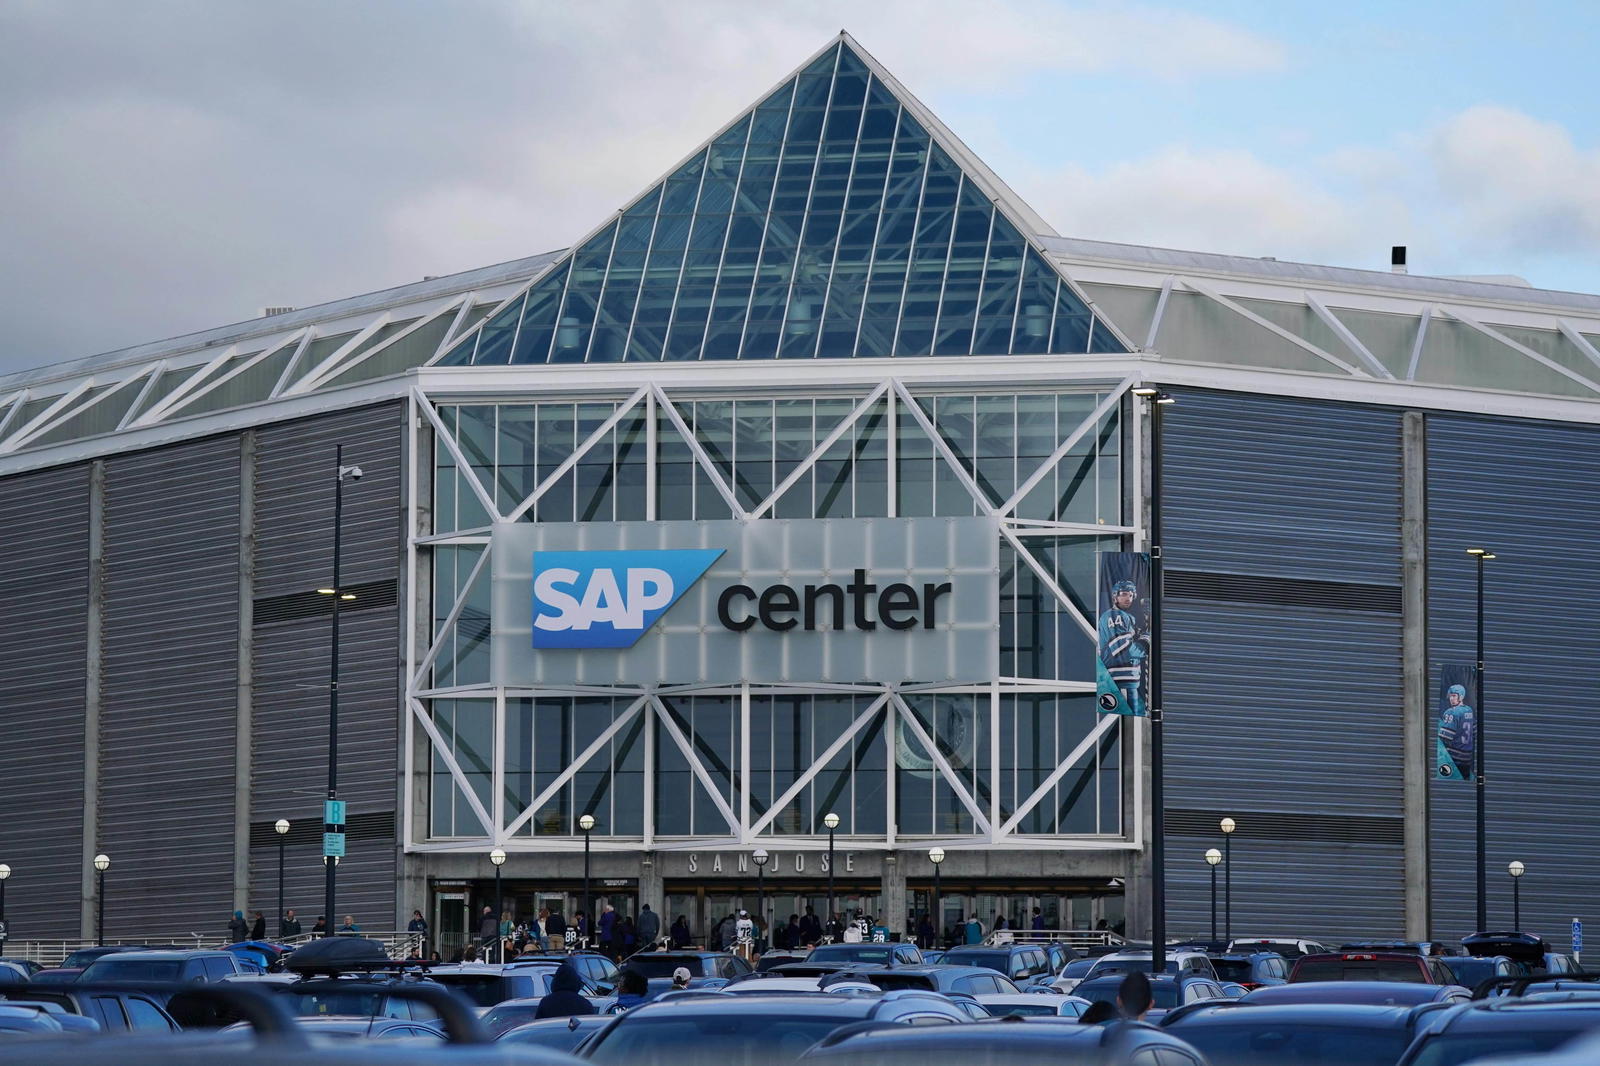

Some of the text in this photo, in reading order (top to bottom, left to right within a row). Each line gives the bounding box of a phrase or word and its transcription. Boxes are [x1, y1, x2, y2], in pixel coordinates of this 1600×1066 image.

[533, 567, 953, 632] SAP center
[1107, 615, 1122, 628] 44
[332, 802, 341, 823] B
[688, 853, 855, 873] SAN JOSE
[565, 931, 577, 942] 88
[740, 927, 752, 937] 72
